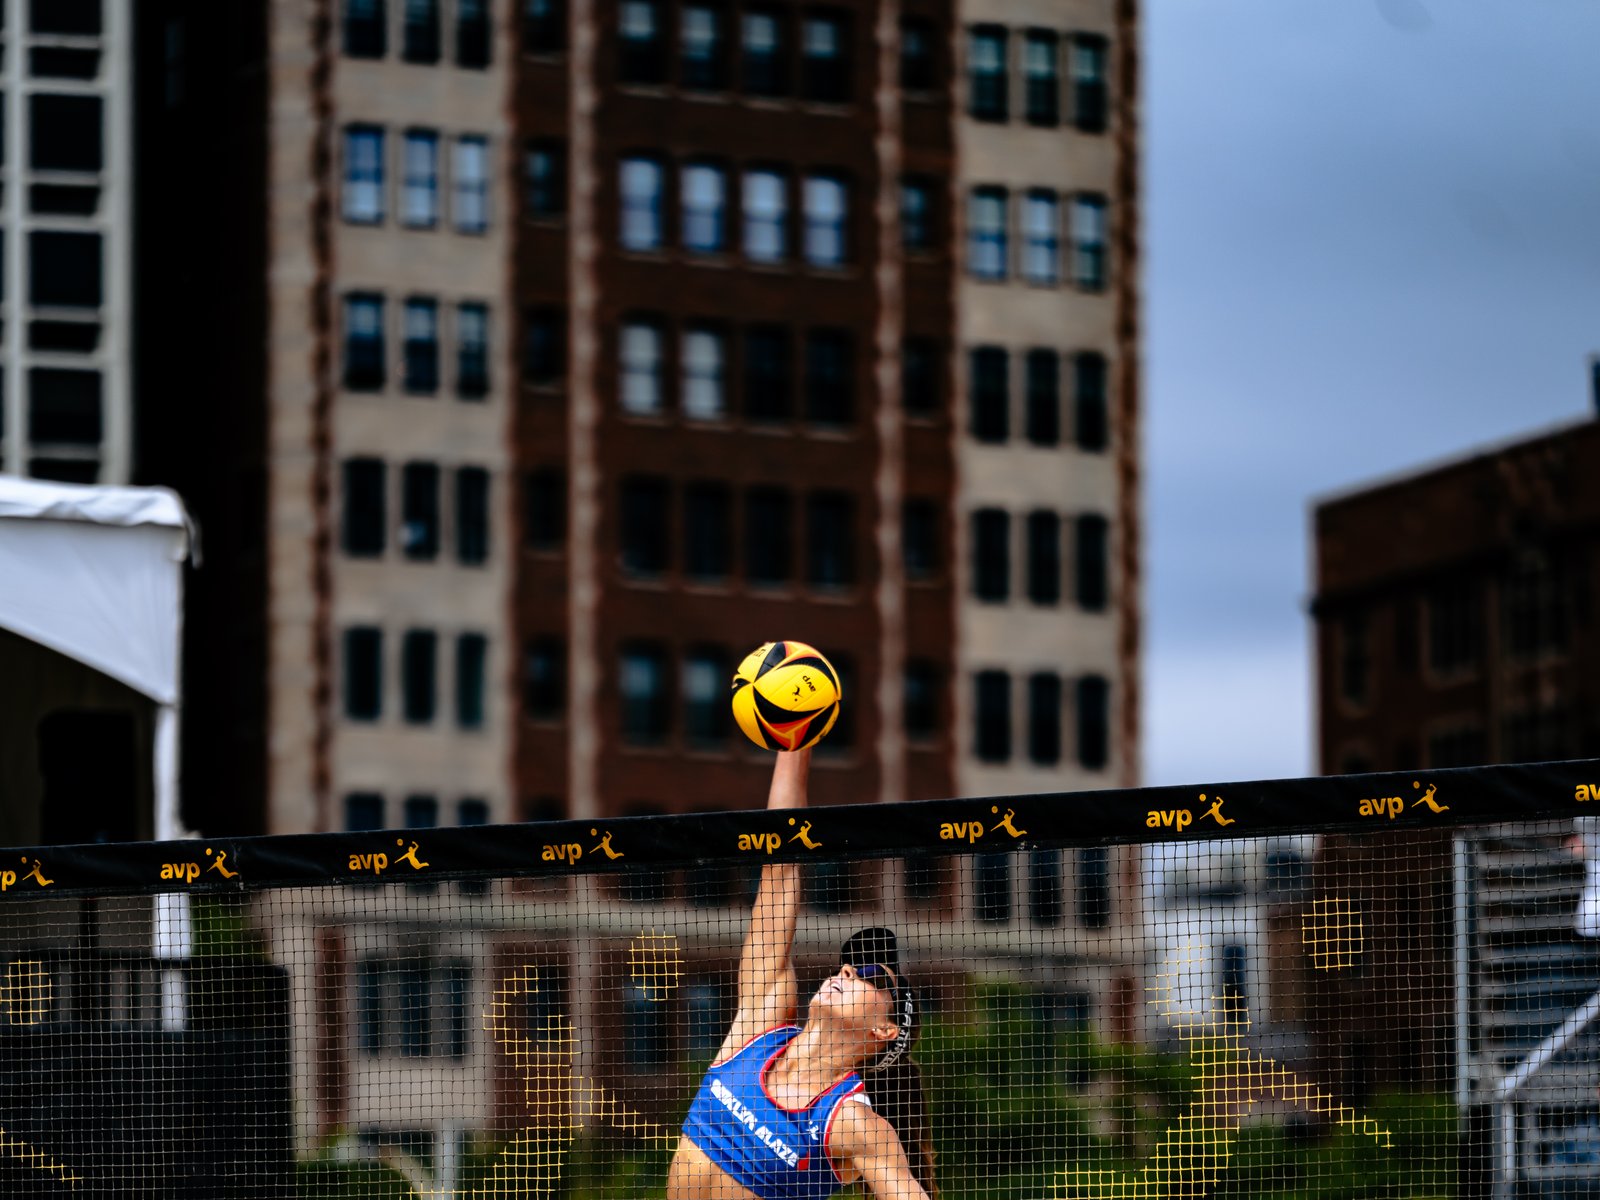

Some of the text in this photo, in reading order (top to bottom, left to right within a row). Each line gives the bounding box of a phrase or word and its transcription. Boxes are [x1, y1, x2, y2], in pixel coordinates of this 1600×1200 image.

[802, 675, 817, 692] avp
[1574, 783, 1600, 802] av
[1358, 796, 1404, 819] avp
[1145, 809, 1193, 832] avp
[737, 832, 782, 855] avp
[939, 821, 984, 844] avp
[348, 852, 388, 875] avp
[541, 843, 583, 865] avp
[160, 863, 201, 884] avp
